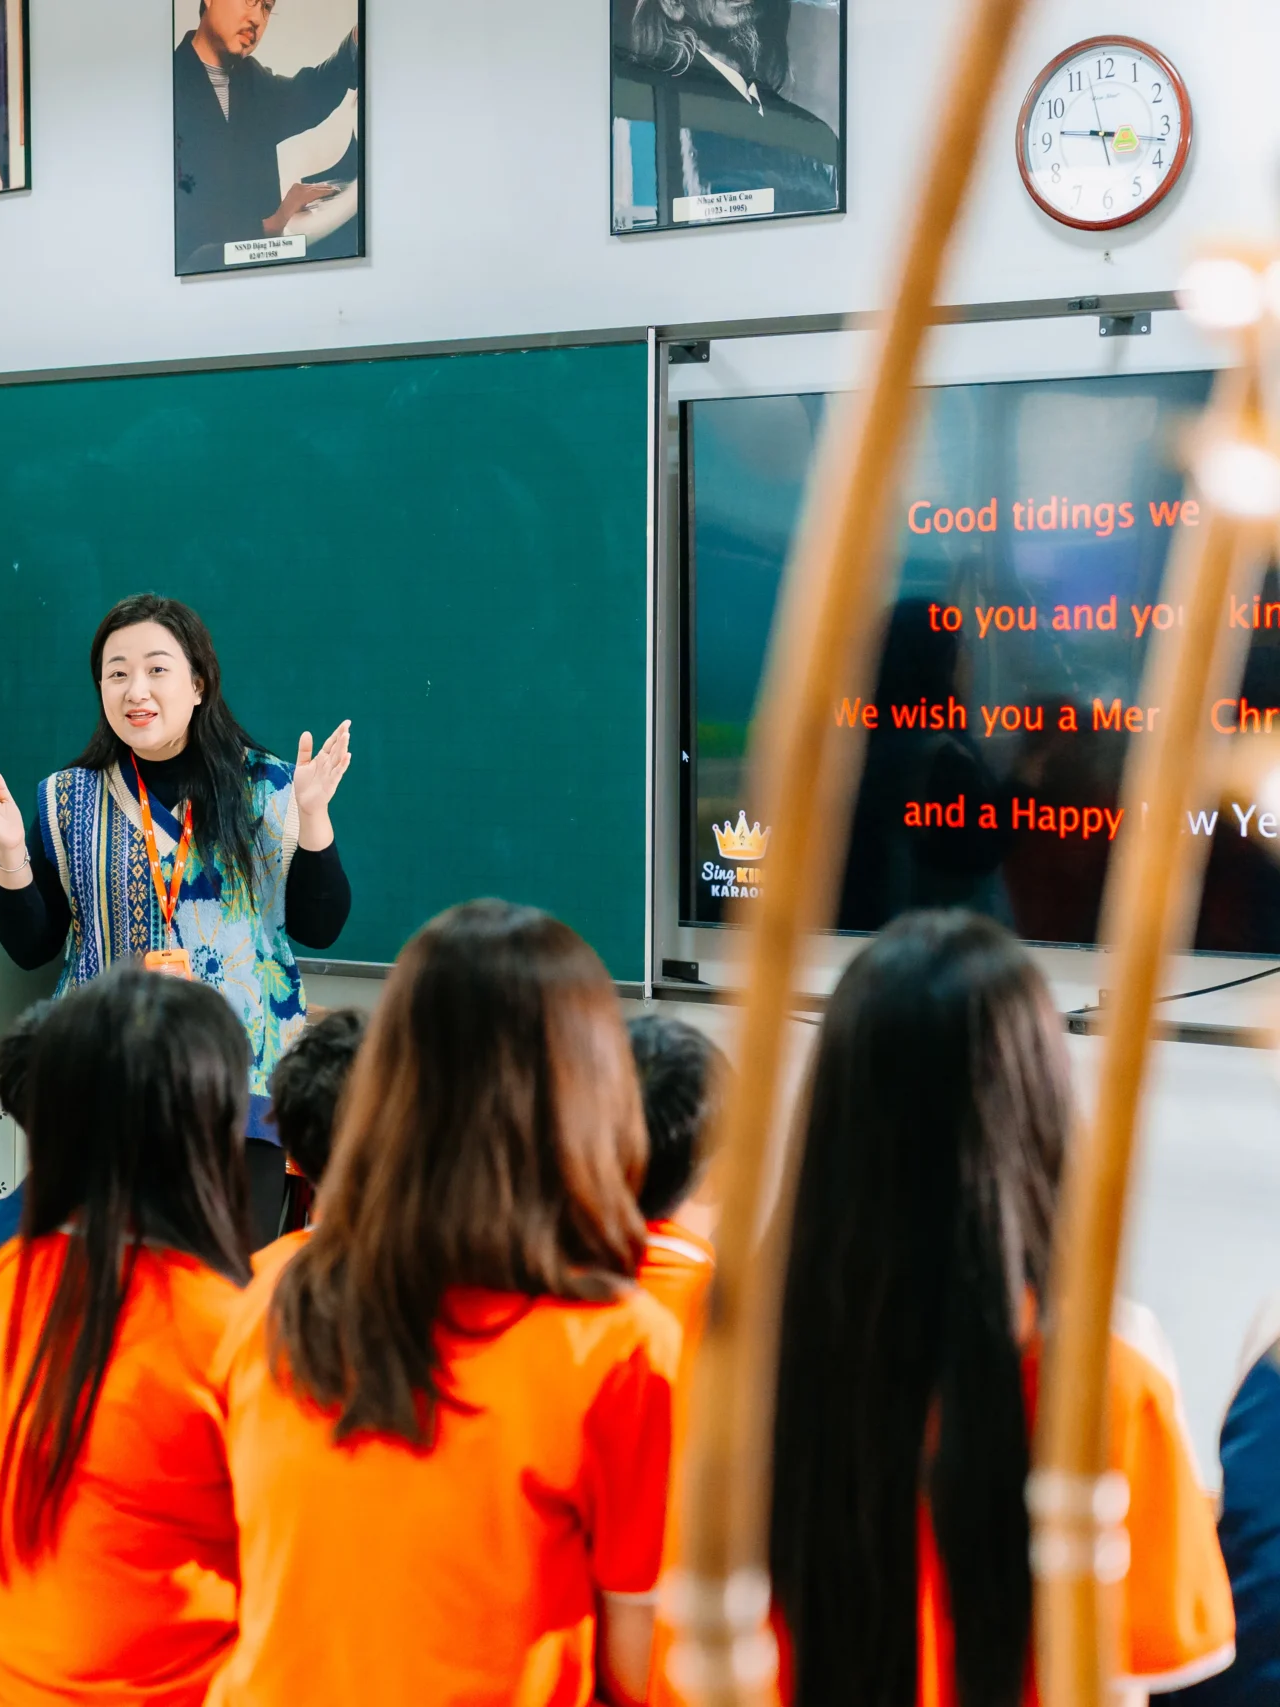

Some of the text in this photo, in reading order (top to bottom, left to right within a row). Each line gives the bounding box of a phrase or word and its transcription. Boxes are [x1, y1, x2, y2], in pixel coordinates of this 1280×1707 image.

[1096, 57, 1115, 80] 12
[1131, 62, 1139, 83] 1
[1067, 71, 1082, 92] 11
[1152, 82, 1162, 103] 2
[1047, 97, 1065, 119] 10
[1160, 114, 1171, 136] 3
[1041, 132, 1052, 153] 9
[1152, 148, 1163, 169] 4
[1051, 162, 1061, 184] 8
[723, 194, 737, 202] Văn
[738, 192, 753, 200] Cao
[1072, 185, 1082, 205] 7
[1131, 176, 1142, 197] 5
[729, 204, 747, 213] 1995)
[1102, 188, 1113, 210] 6
[908, 496, 1200, 537] Good tidings we
[928, 602, 963, 632] to
[975, 604, 1037, 639] you
[1051, 595, 1117, 630] and
[834, 697, 878, 729] We
[891, 696, 967, 730] wish
[980, 704, 1044, 738] you
[1058, 703, 1077, 731] a
[903, 794, 966, 828] and
[978, 803, 998, 830] a
[1011, 798, 1125, 840] Happy
[701, 861, 736, 887] Sing
